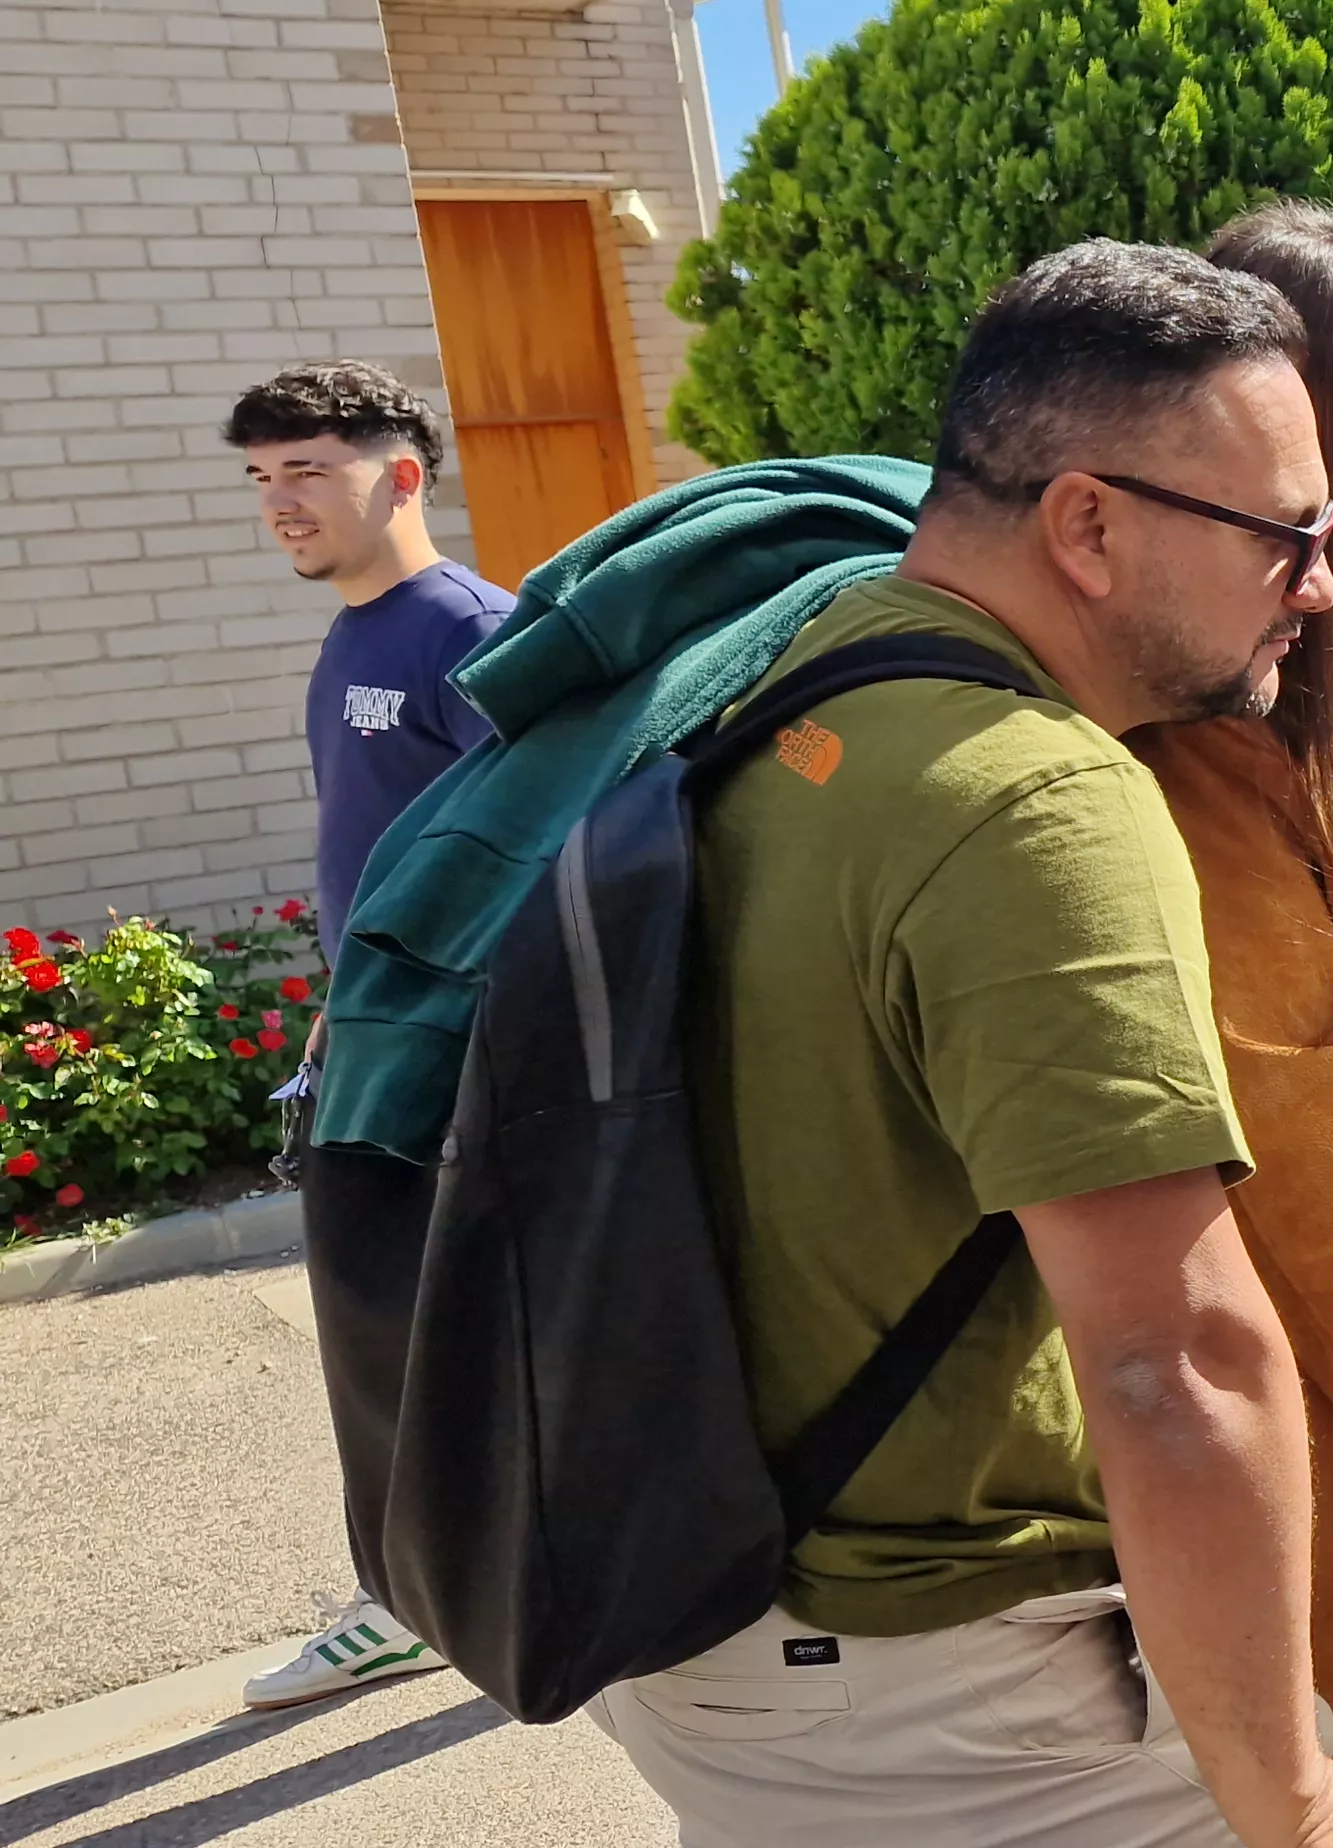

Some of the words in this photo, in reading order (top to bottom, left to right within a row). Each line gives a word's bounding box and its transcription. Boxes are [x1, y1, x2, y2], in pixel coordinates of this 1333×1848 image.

[343, 685, 406, 727] TOMMY
[350, 714, 389, 731] JEANS
[801, 719, 831, 745] THE
[778, 730, 816, 758] ORTH
[776, 745, 812, 776] FACE
